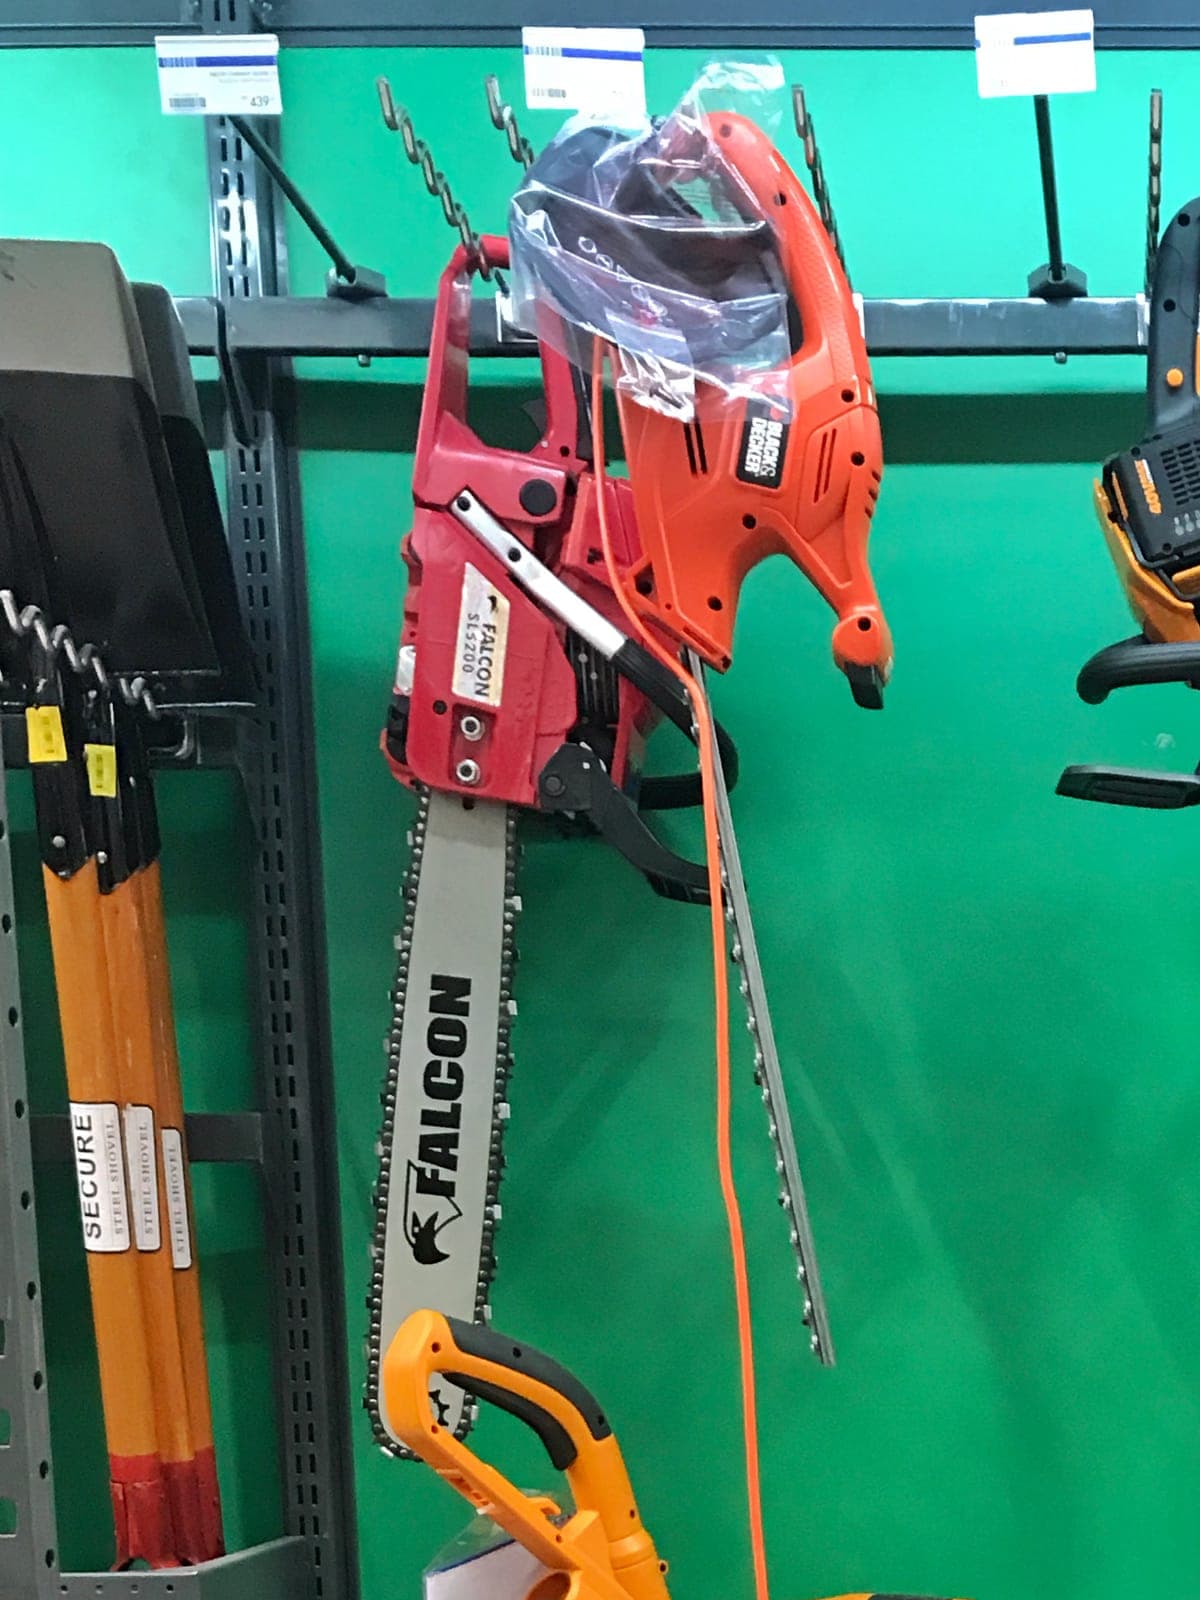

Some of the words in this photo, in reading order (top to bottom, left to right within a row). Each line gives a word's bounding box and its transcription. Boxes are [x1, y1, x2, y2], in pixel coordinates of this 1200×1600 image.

[250, 95, 269, 107] 439
[474, 623, 497, 698] FALCON
[416, 974, 472, 1198] FALCON
[74, 1114, 101, 1239] SECURE
